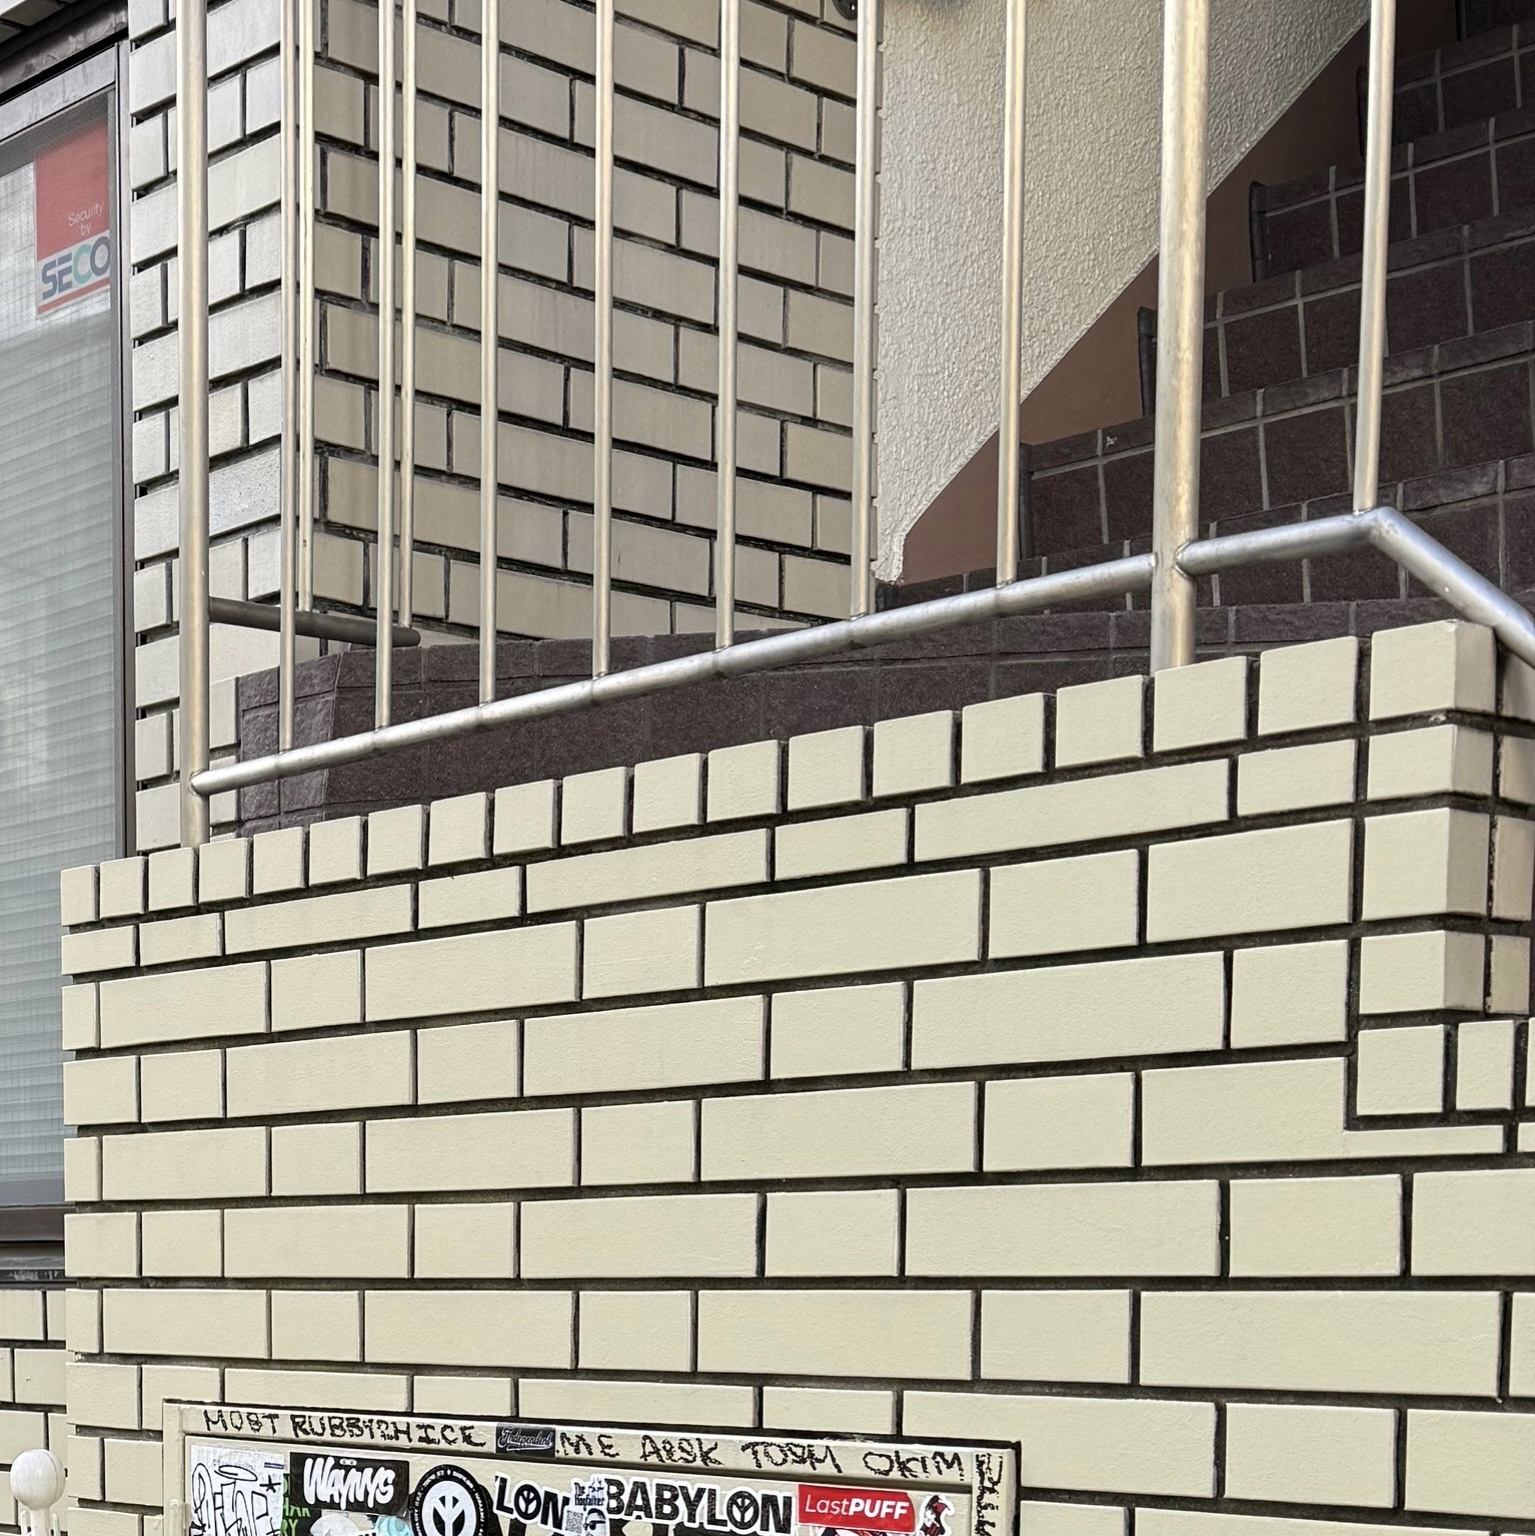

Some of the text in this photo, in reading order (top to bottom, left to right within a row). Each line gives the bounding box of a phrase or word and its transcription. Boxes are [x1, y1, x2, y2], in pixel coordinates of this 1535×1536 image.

[68, 202, 104, 227] Security
[79, 223, 92, 237] by
[604, 1477, 793, 1535] BABYLON
[805, 1494, 910, 1520] LastPUFF
